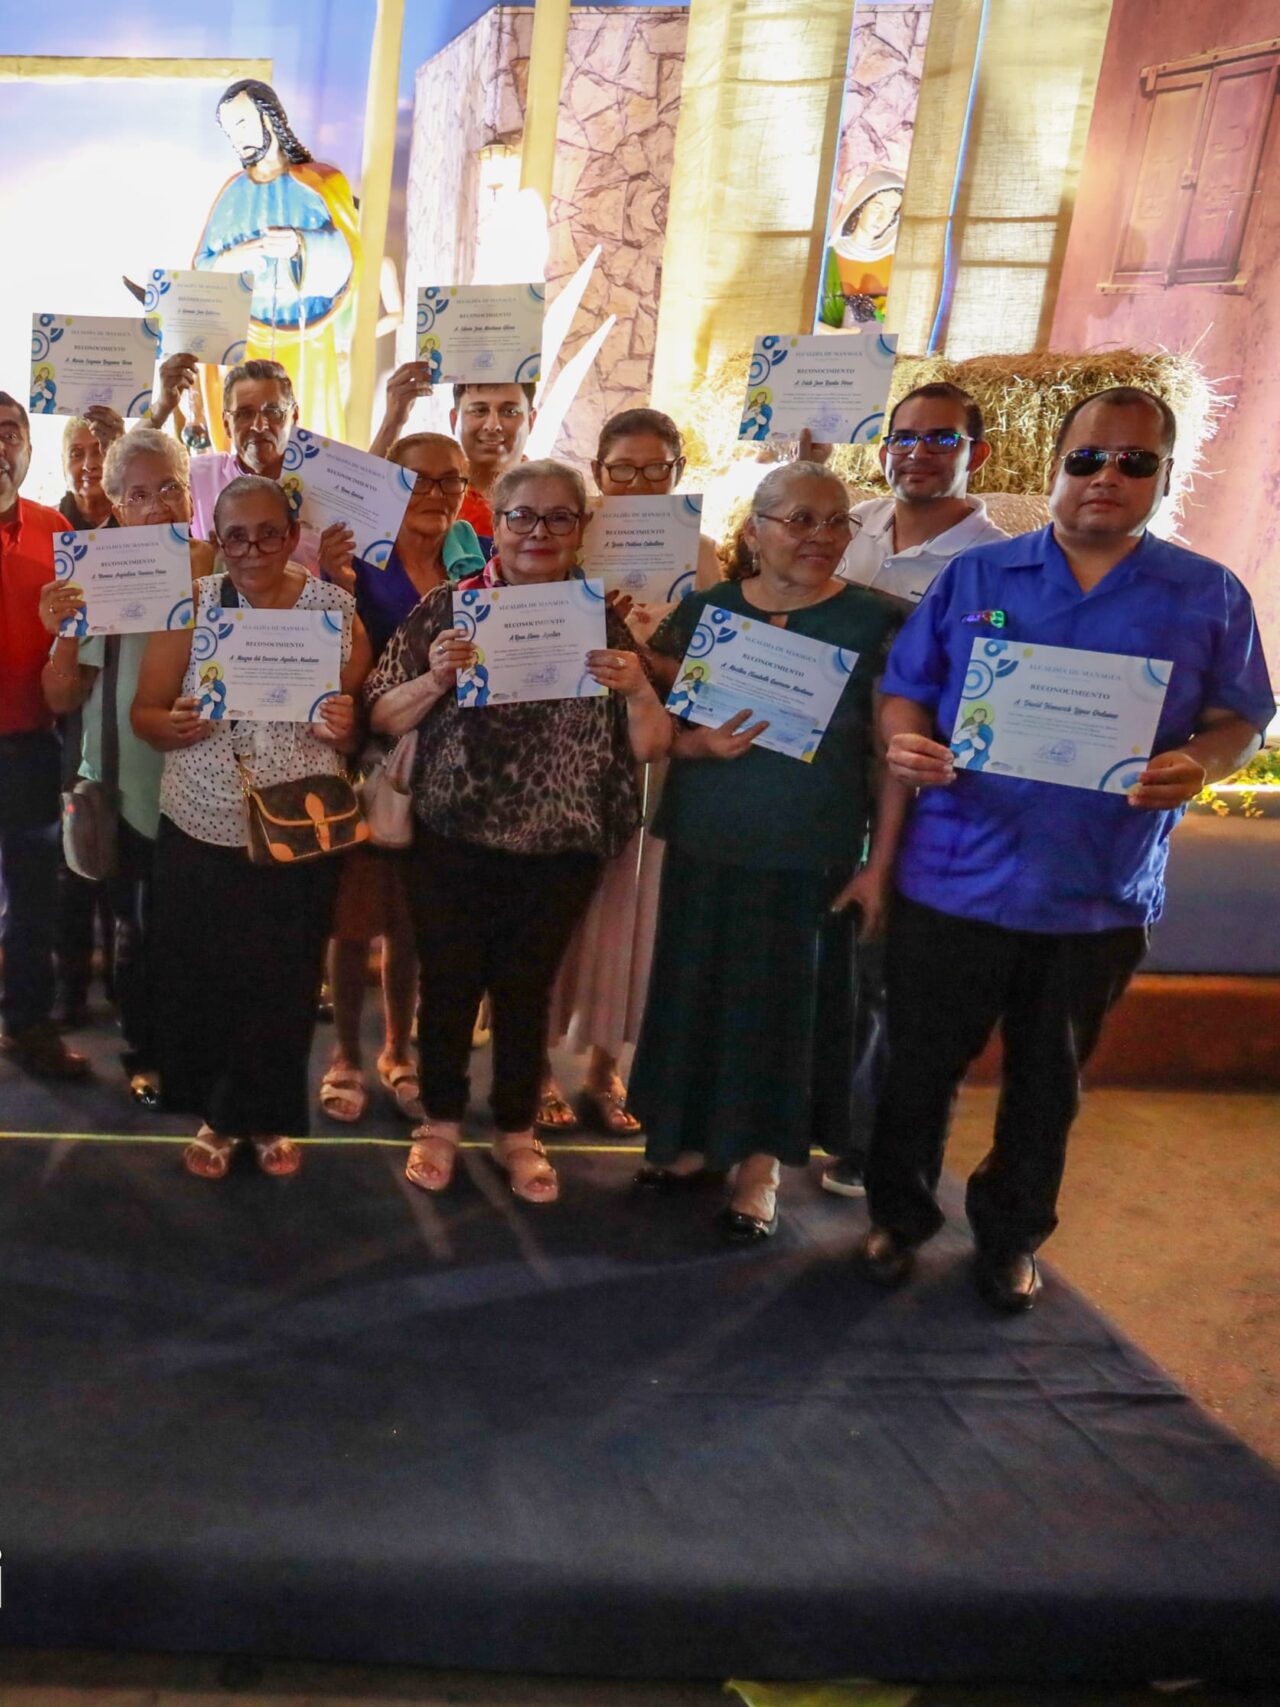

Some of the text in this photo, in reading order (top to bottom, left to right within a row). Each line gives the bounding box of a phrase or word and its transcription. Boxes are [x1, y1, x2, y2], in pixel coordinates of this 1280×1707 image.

[101, 558, 156, 567] RECONOCIMIENTO
[504, 618, 565, 628] RECONOCIMIENTO
[742, 653, 805, 678] RECONOCIMIENTO
[1030, 684, 1111, 700] RECONOCIMIENTO
